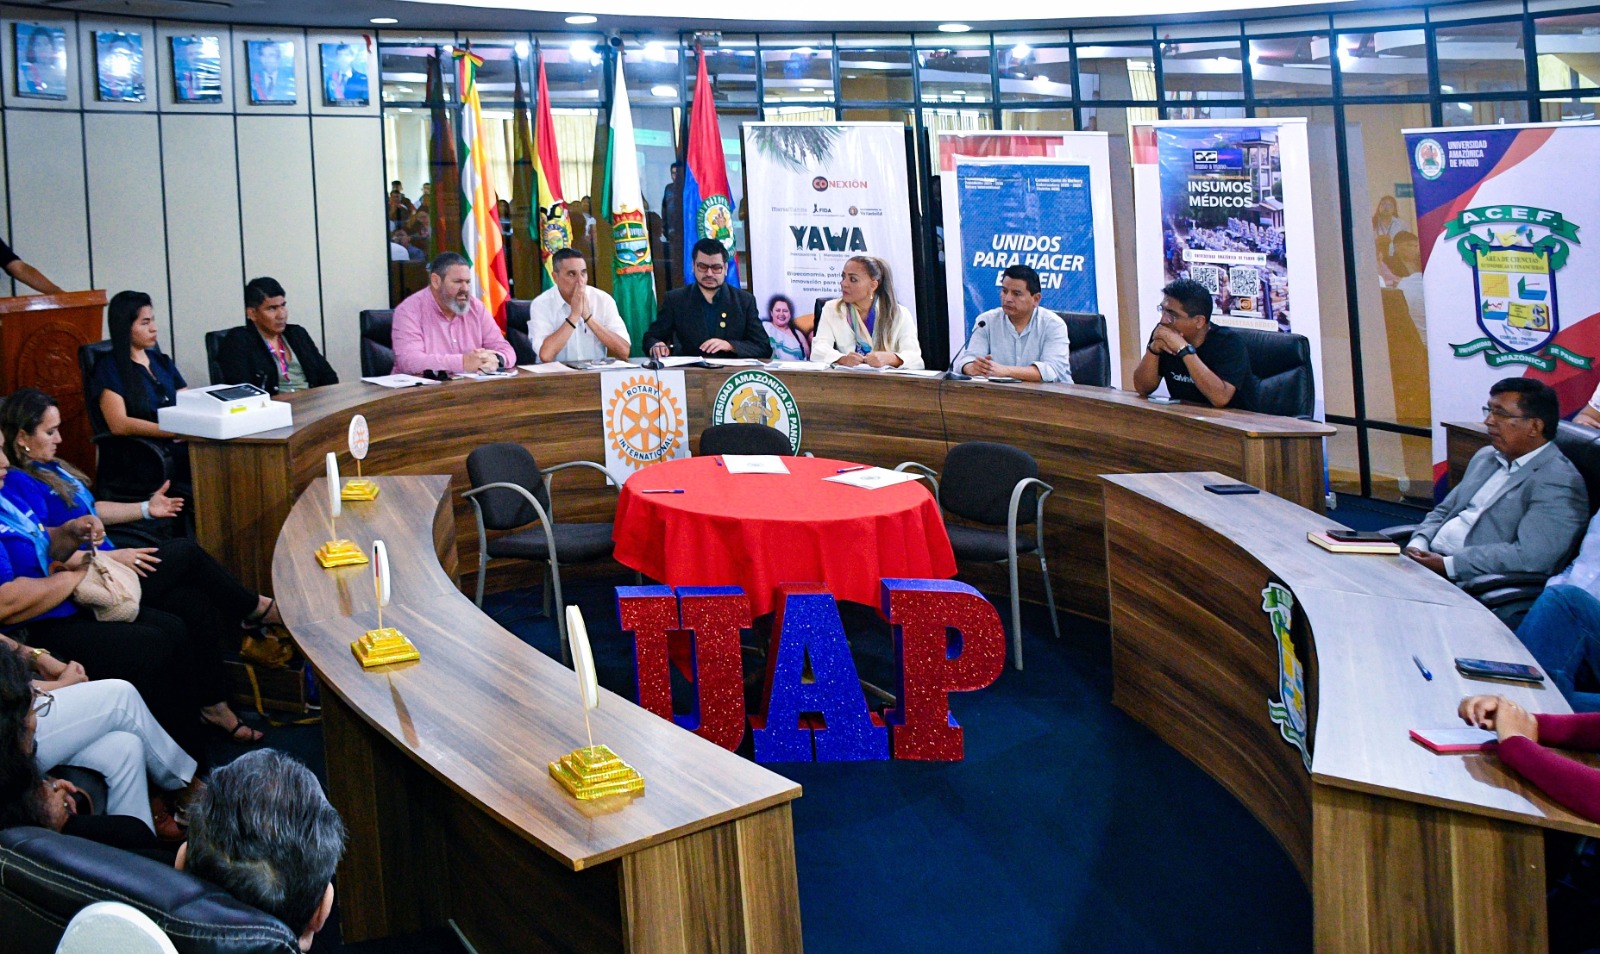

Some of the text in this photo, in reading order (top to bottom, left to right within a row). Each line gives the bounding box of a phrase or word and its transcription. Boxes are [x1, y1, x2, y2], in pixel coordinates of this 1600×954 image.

[1448, 140, 1488, 149] UNIVERSIDAD
[1448, 149, 1484, 158] AMAZÓNICA
[1450, 159, 1479, 167] DE PANDO
[1188, 182, 1252, 193] INSUMOS
[1189, 194, 1253, 208] MÉDICOS
[1463, 208, 1557, 225] A.C.E.F.
[789, 226, 867, 252] YAWA
[992, 234, 1062, 252] UNIDOS
[973, 252, 1084, 271] PARA HACER
[1040, 273, 1063, 289] EN
[1560, 349, 1584, 365] PANDO
[626, 386, 659, 397] ROTARY
[716, 383, 734, 425] ERSIDAD
[734, 374, 786, 401] AMAZÓNICA
[785, 401, 795, 415] DE
[619, 438, 673, 460] INTERNATIONAL
[614, 578, 1006, 762] UAP
